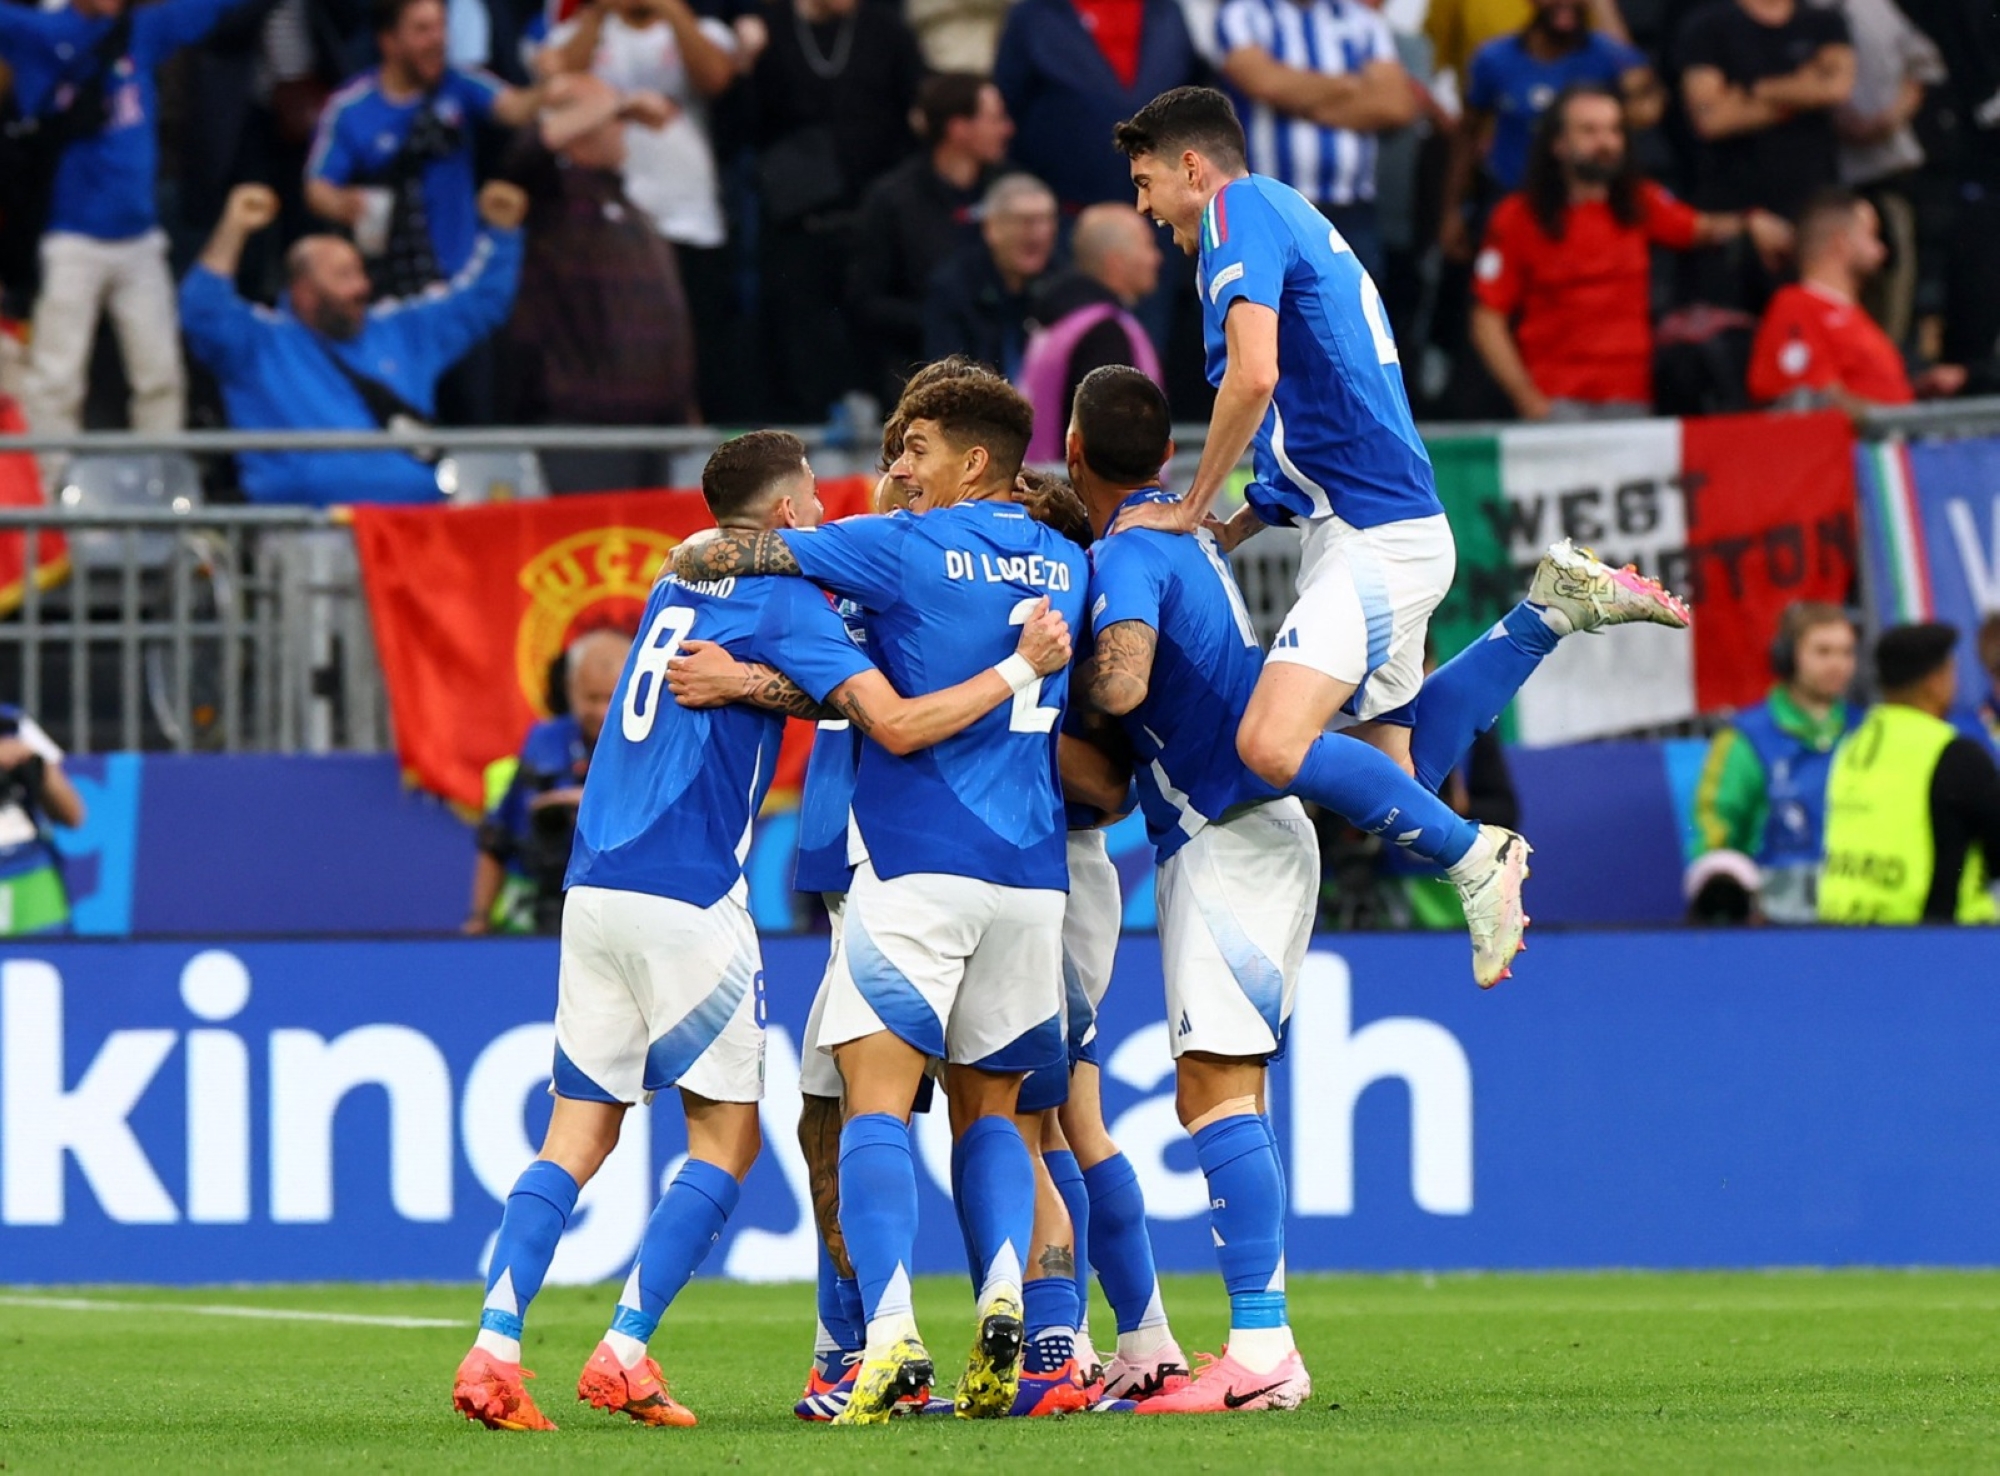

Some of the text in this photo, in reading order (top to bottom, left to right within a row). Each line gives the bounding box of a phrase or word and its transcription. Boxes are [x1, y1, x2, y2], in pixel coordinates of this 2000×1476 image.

[1482, 474, 1705, 546] WEST
[945, 549, 1070, 592] DI LOREZO
[622, 606, 696, 742] 8
